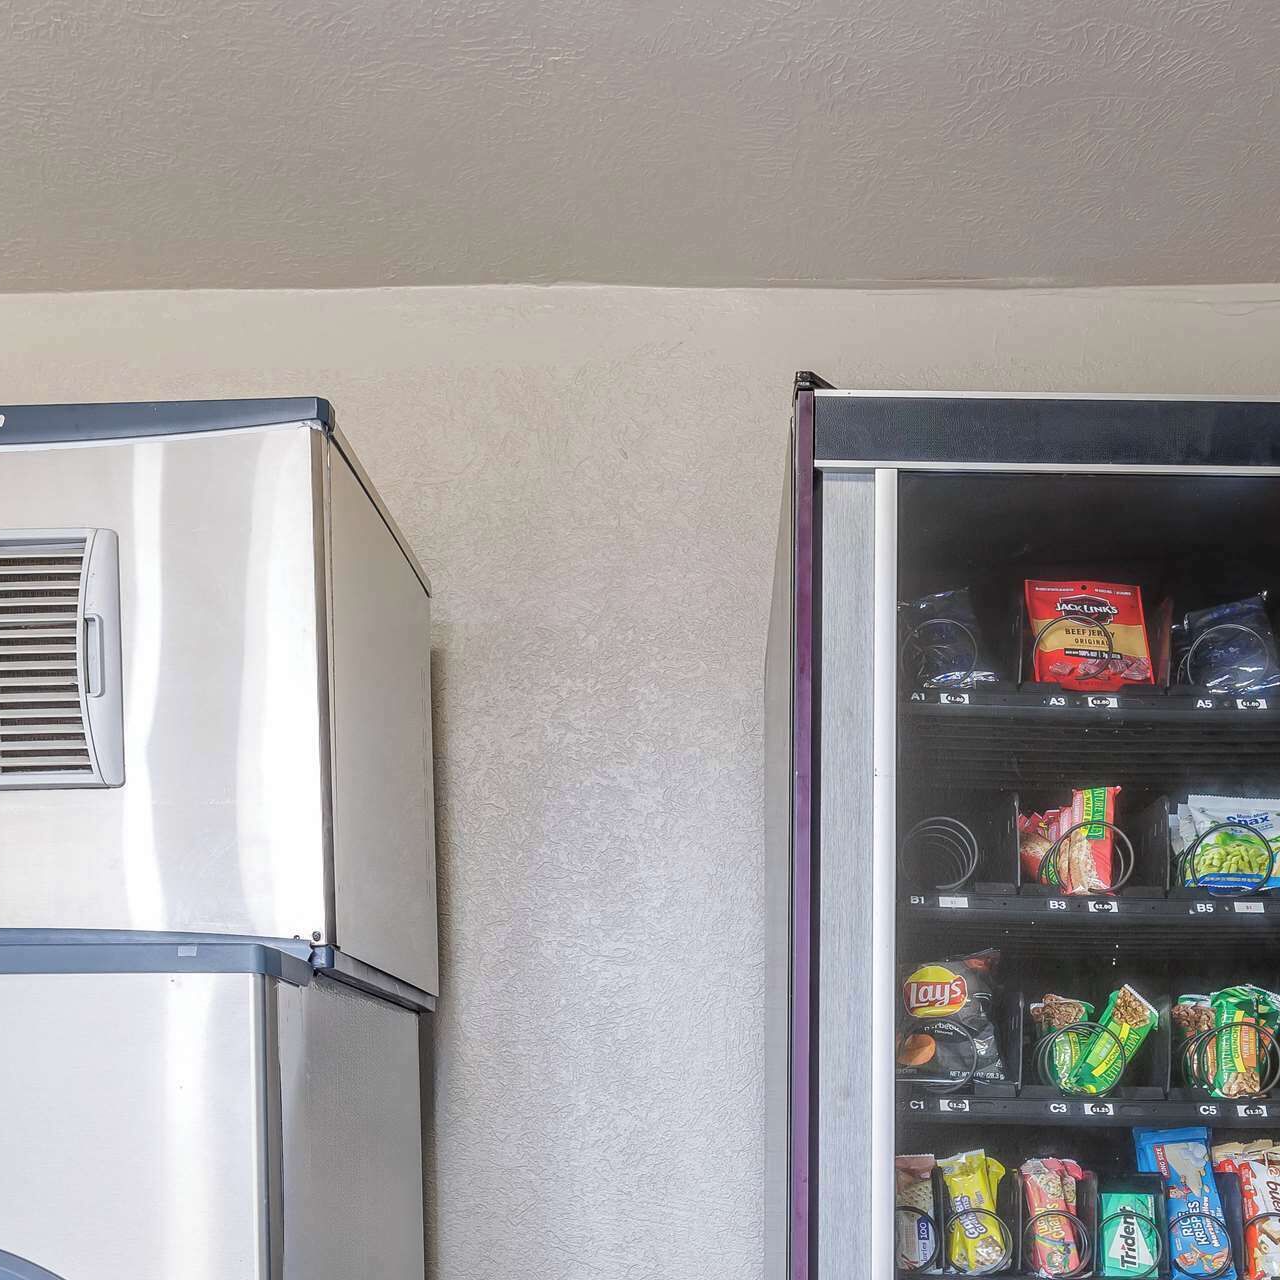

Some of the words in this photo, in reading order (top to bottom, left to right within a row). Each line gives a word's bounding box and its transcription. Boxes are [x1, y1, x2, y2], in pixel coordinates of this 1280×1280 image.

[1056, 602, 1083, 613] JACK
[1081, 604, 1119, 615] LINK'S
[1065, 628, 1087, 636] BEEF
[911, 693, 925, 701] A1
[1050, 698, 1066, 706] A3
[1196, 699, 1212, 708] A5
[1050, 900, 1066, 909] B3
[1197, 904, 1213, 913] B5
[910, 980, 962, 1008] Lay's
[910, 1101, 924, 1109] C1
[1050, 1104, 1067, 1113] C3
[1200, 1105, 1217, 1115] C5
[1159, 1160, 1168, 1177] KING
[1188, 1201, 1210, 1245] KRISPES
[920, 1223, 928, 1239] 100
[1120, 1206, 1137, 1268] Trident
